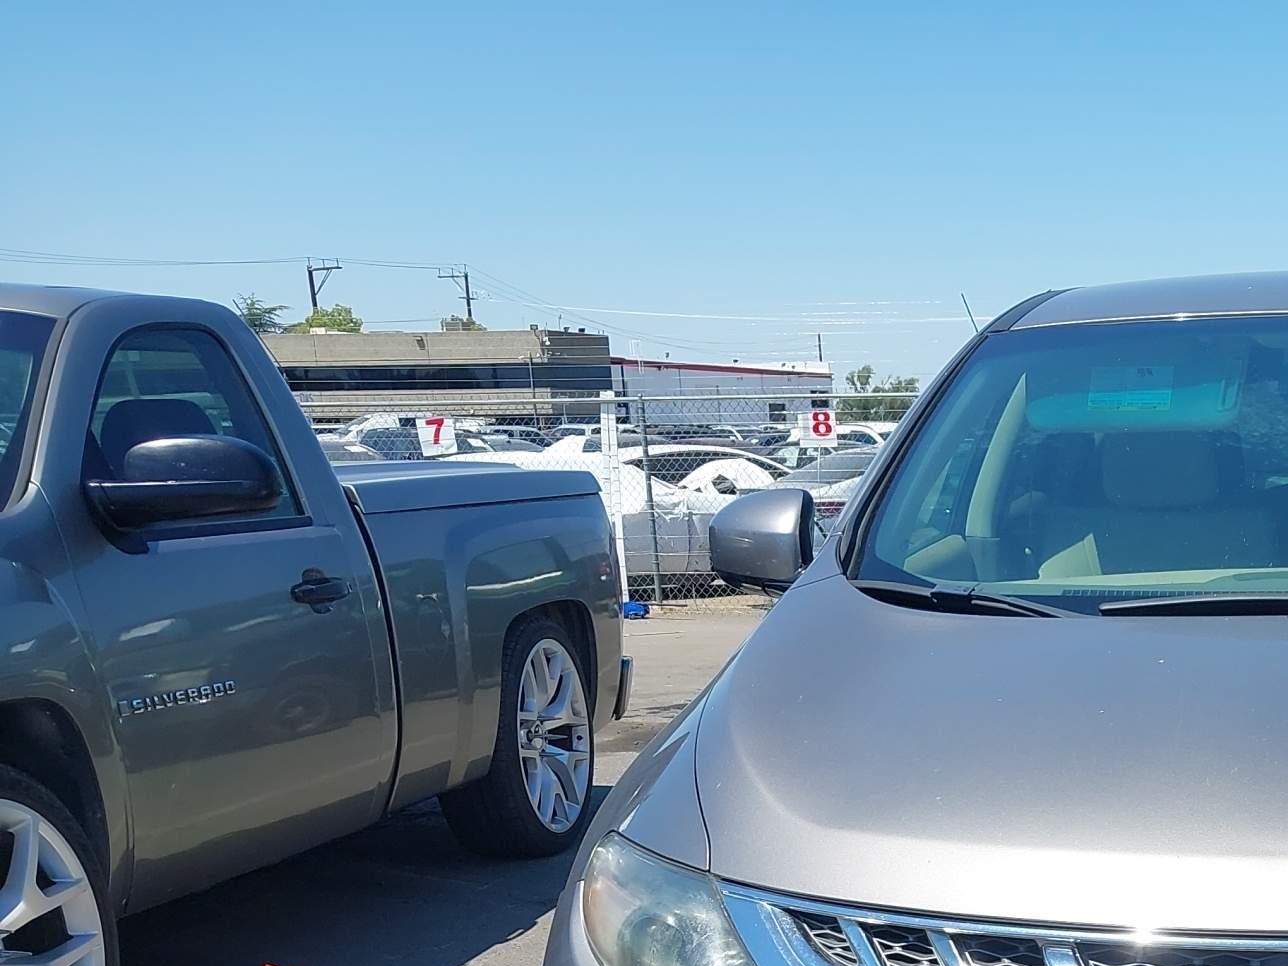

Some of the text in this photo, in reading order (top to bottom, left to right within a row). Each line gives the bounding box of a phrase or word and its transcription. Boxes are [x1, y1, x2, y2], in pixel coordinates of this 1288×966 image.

[425, 418, 444, 444] 7
[812, 411, 832, 437] 8
[132, 680, 236, 714] SILVERADO
